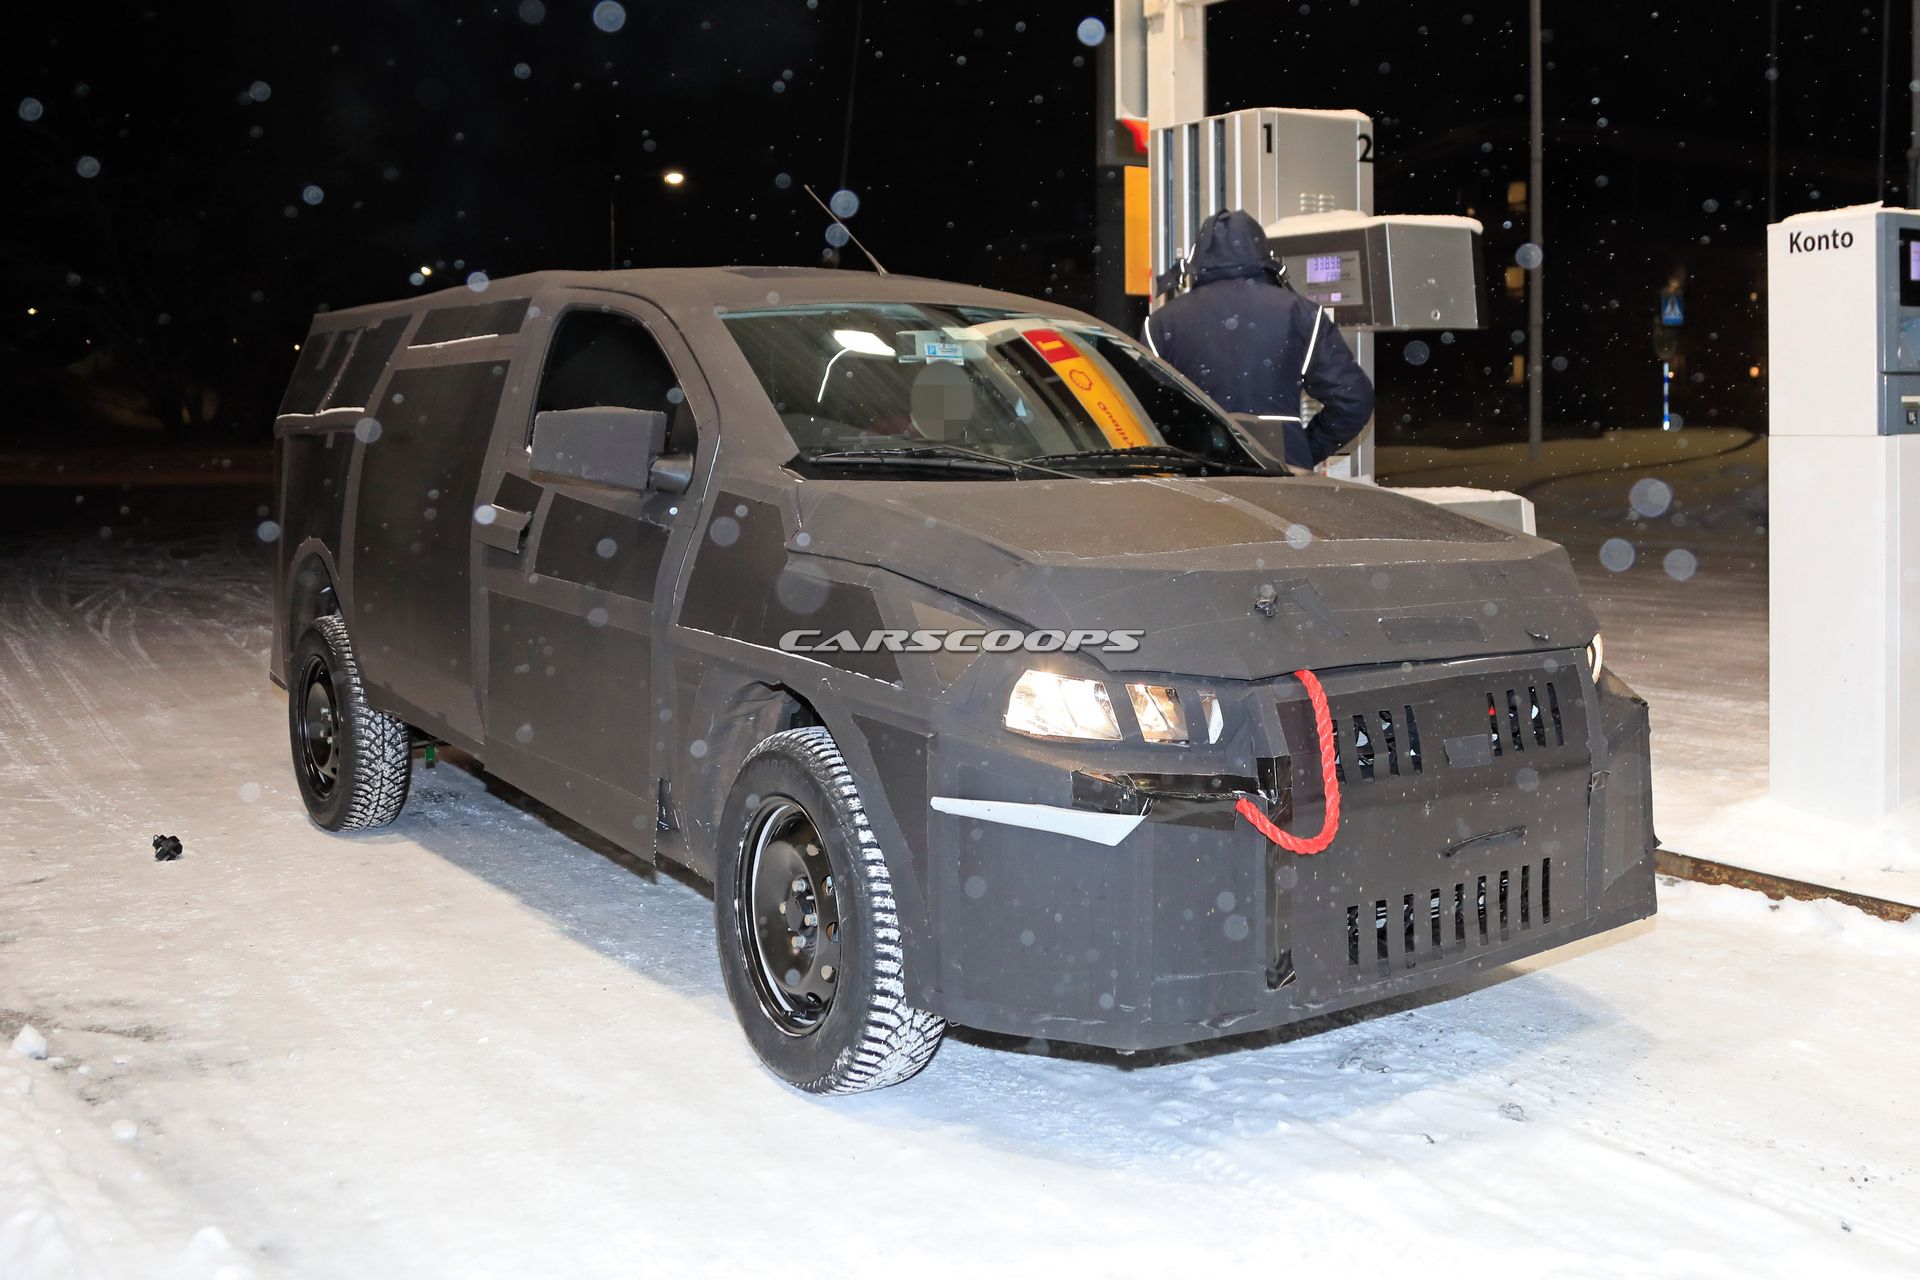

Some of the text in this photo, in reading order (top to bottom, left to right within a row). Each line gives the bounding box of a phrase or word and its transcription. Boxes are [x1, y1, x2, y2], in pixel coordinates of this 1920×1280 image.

[1263, 123, 1272, 153] 1
[1358, 133, 1375, 162] 2
[1789, 228, 1854, 253] Konto
